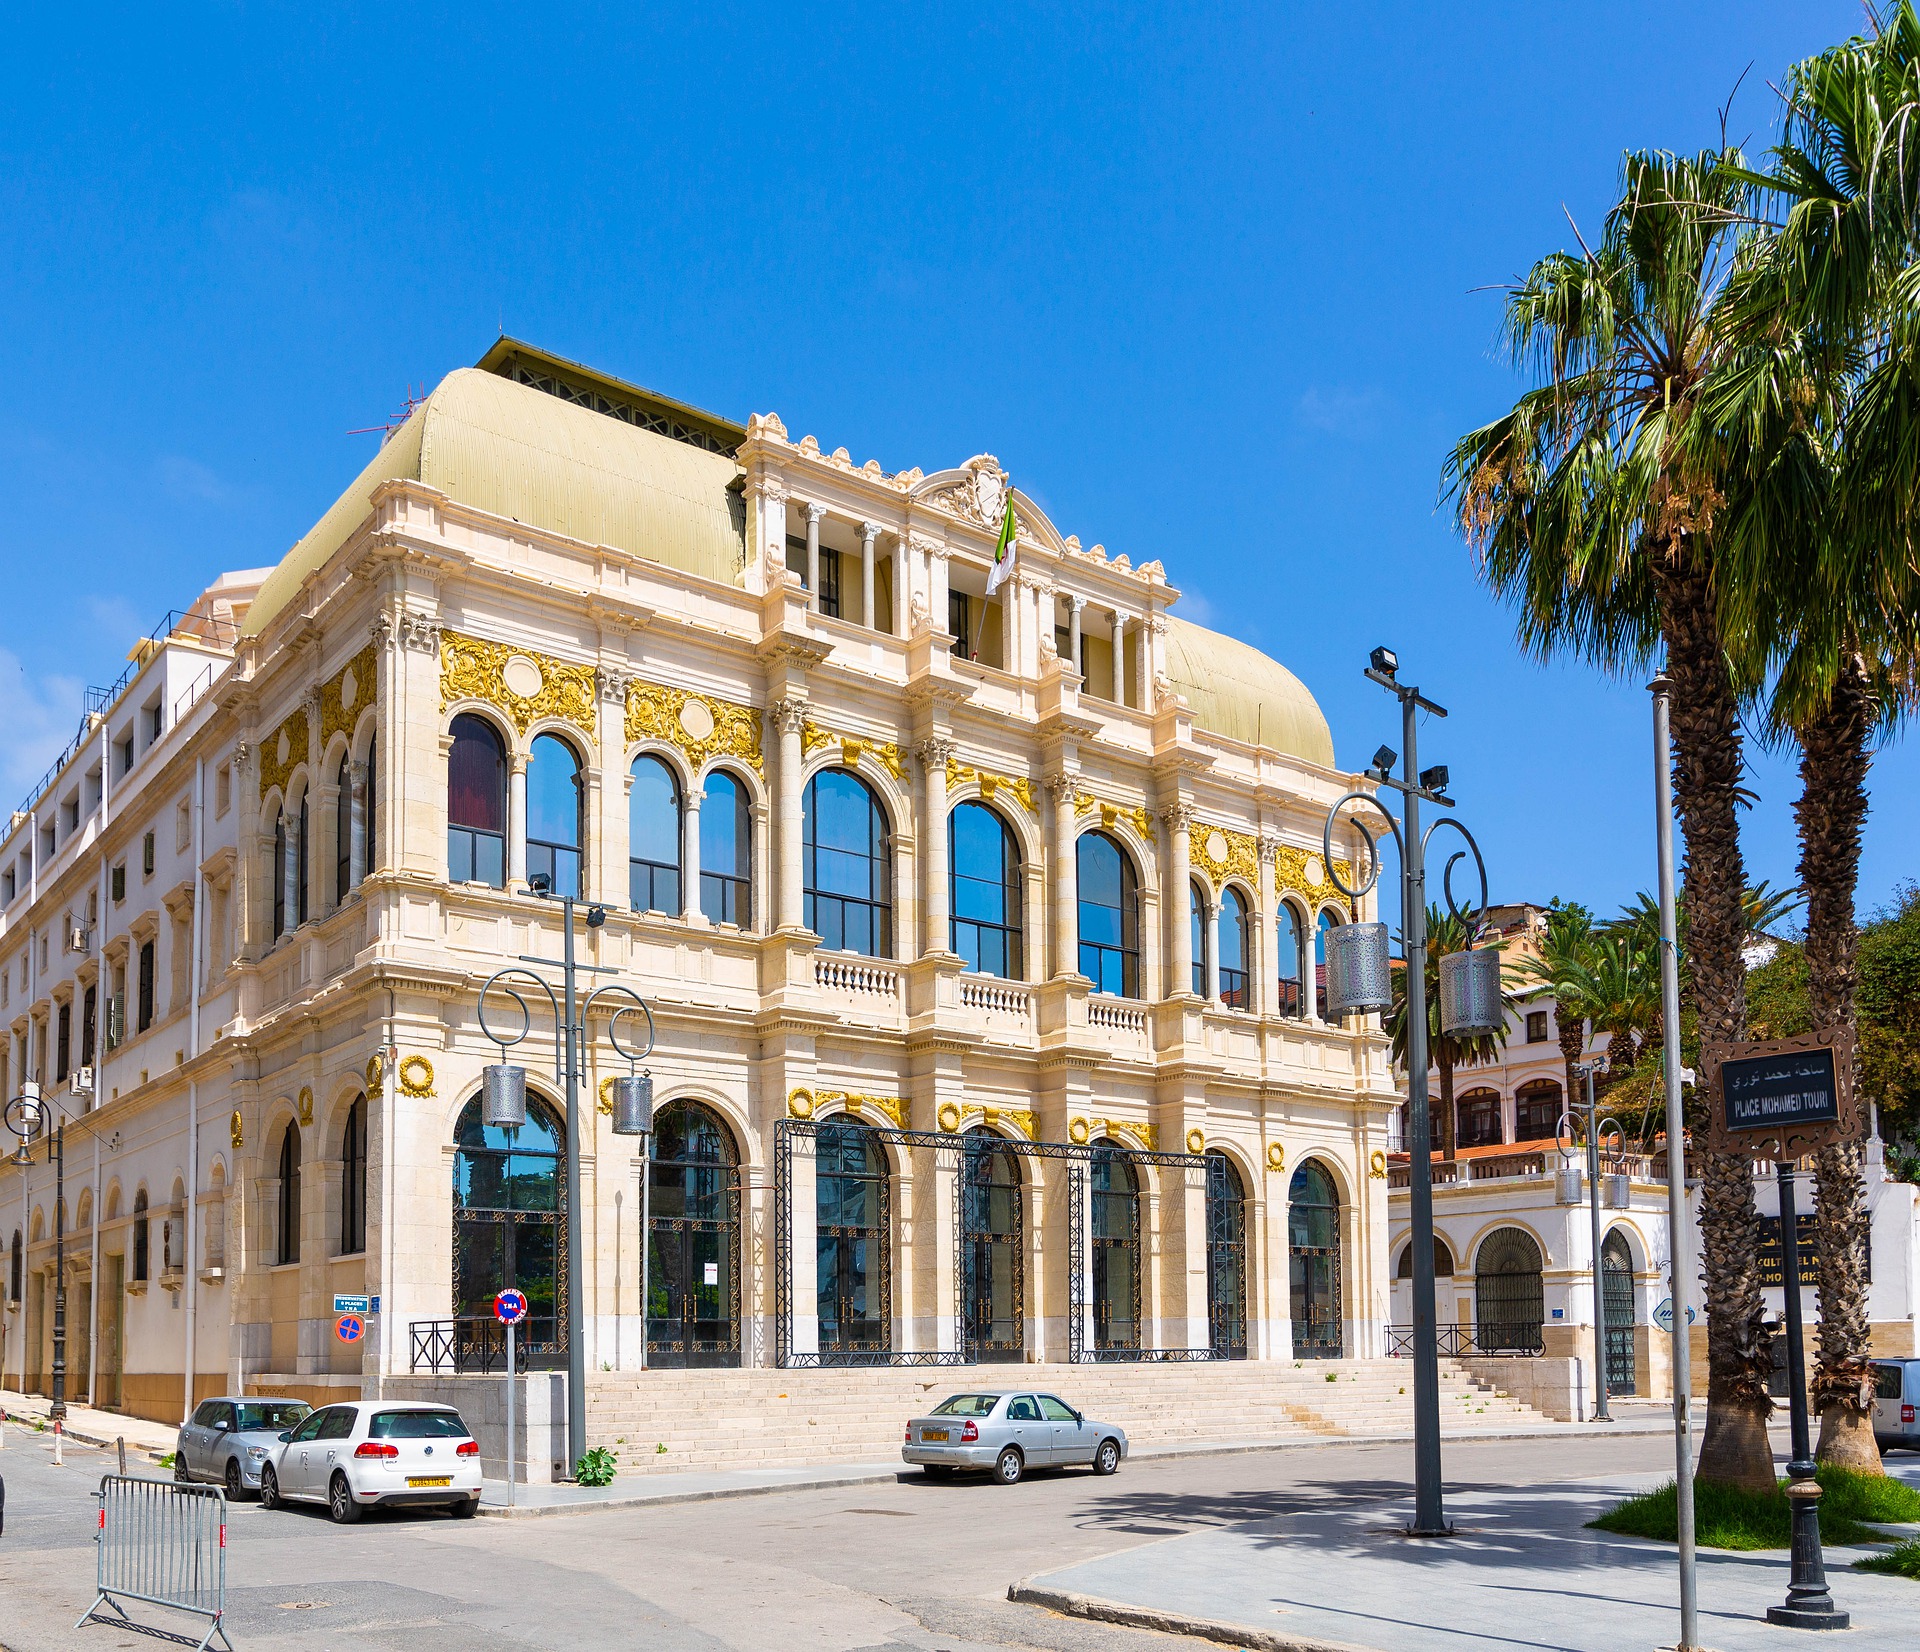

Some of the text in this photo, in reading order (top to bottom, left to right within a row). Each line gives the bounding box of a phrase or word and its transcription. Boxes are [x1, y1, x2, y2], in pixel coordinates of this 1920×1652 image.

[1764, 1071, 1791, 1081] محمد
[1795, 1063, 1825, 1076] ساحة
[1735, 1090, 1829, 1118] PLACE MOHAMED TOURI
